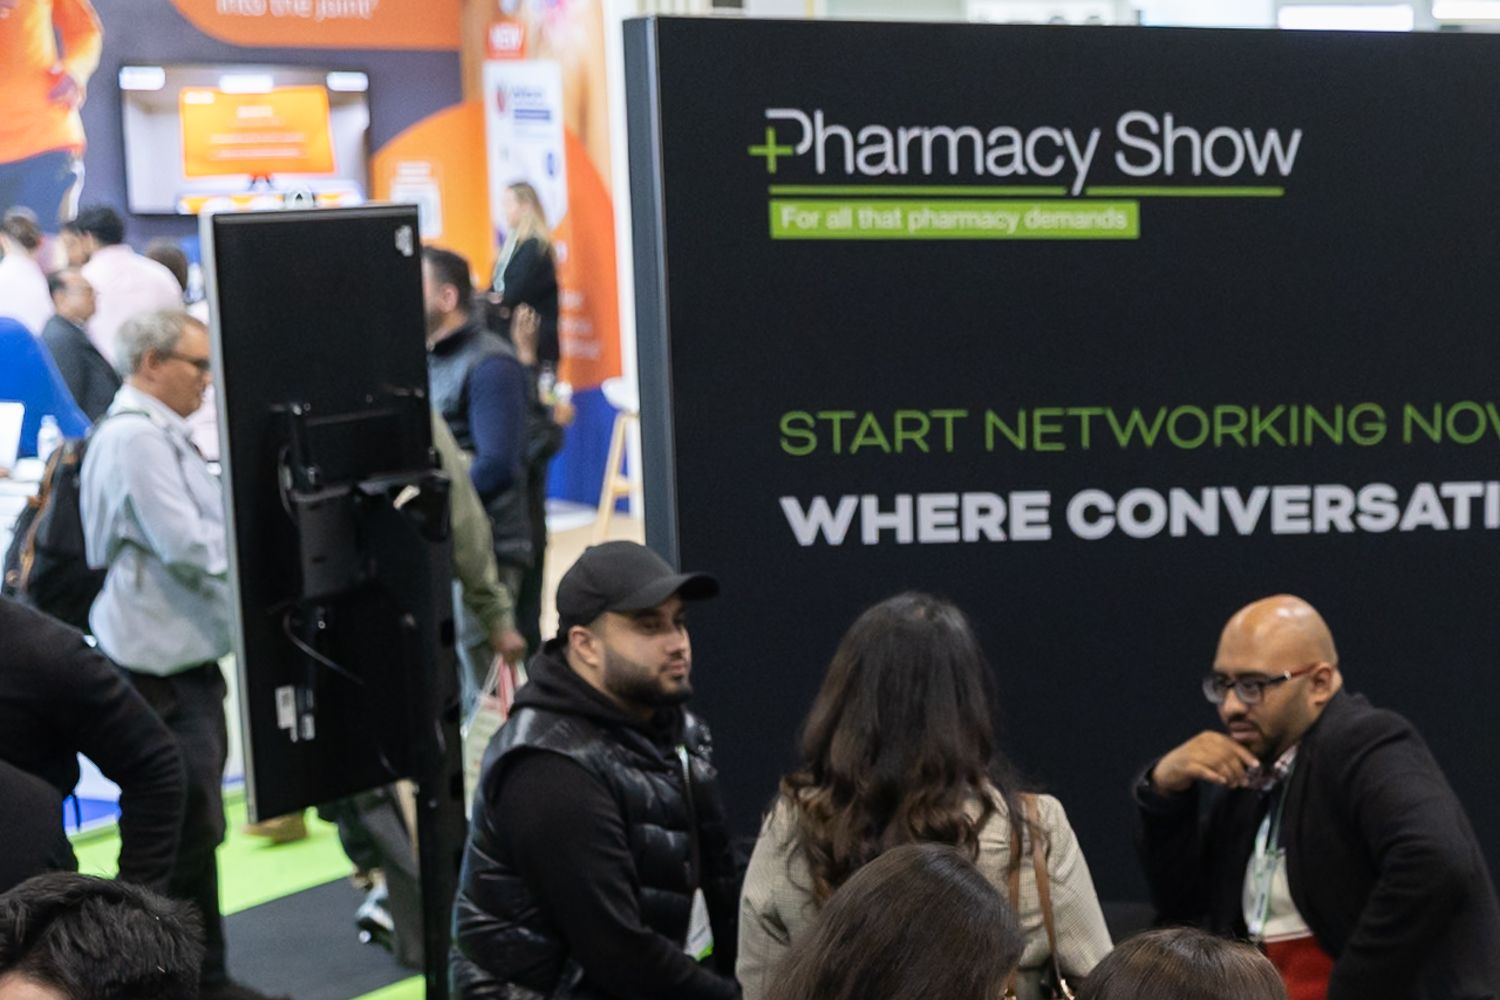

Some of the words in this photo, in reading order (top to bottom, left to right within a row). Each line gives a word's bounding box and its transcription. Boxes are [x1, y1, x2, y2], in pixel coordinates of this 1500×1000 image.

[748, 108, 1102, 196] Pharmacy
[1114, 110, 1302, 176] Show
[780, 205, 820, 229] For
[826, 206, 853, 230] all
[857, 206, 903, 230] that
[907, 207, 1020, 234] pharmacy
[1024, 207, 1128, 231] demands
[779, 410, 968, 456] START
[985, 403, 1388, 452] NETWORKING
[779, 490, 1052, 547] WHERE
